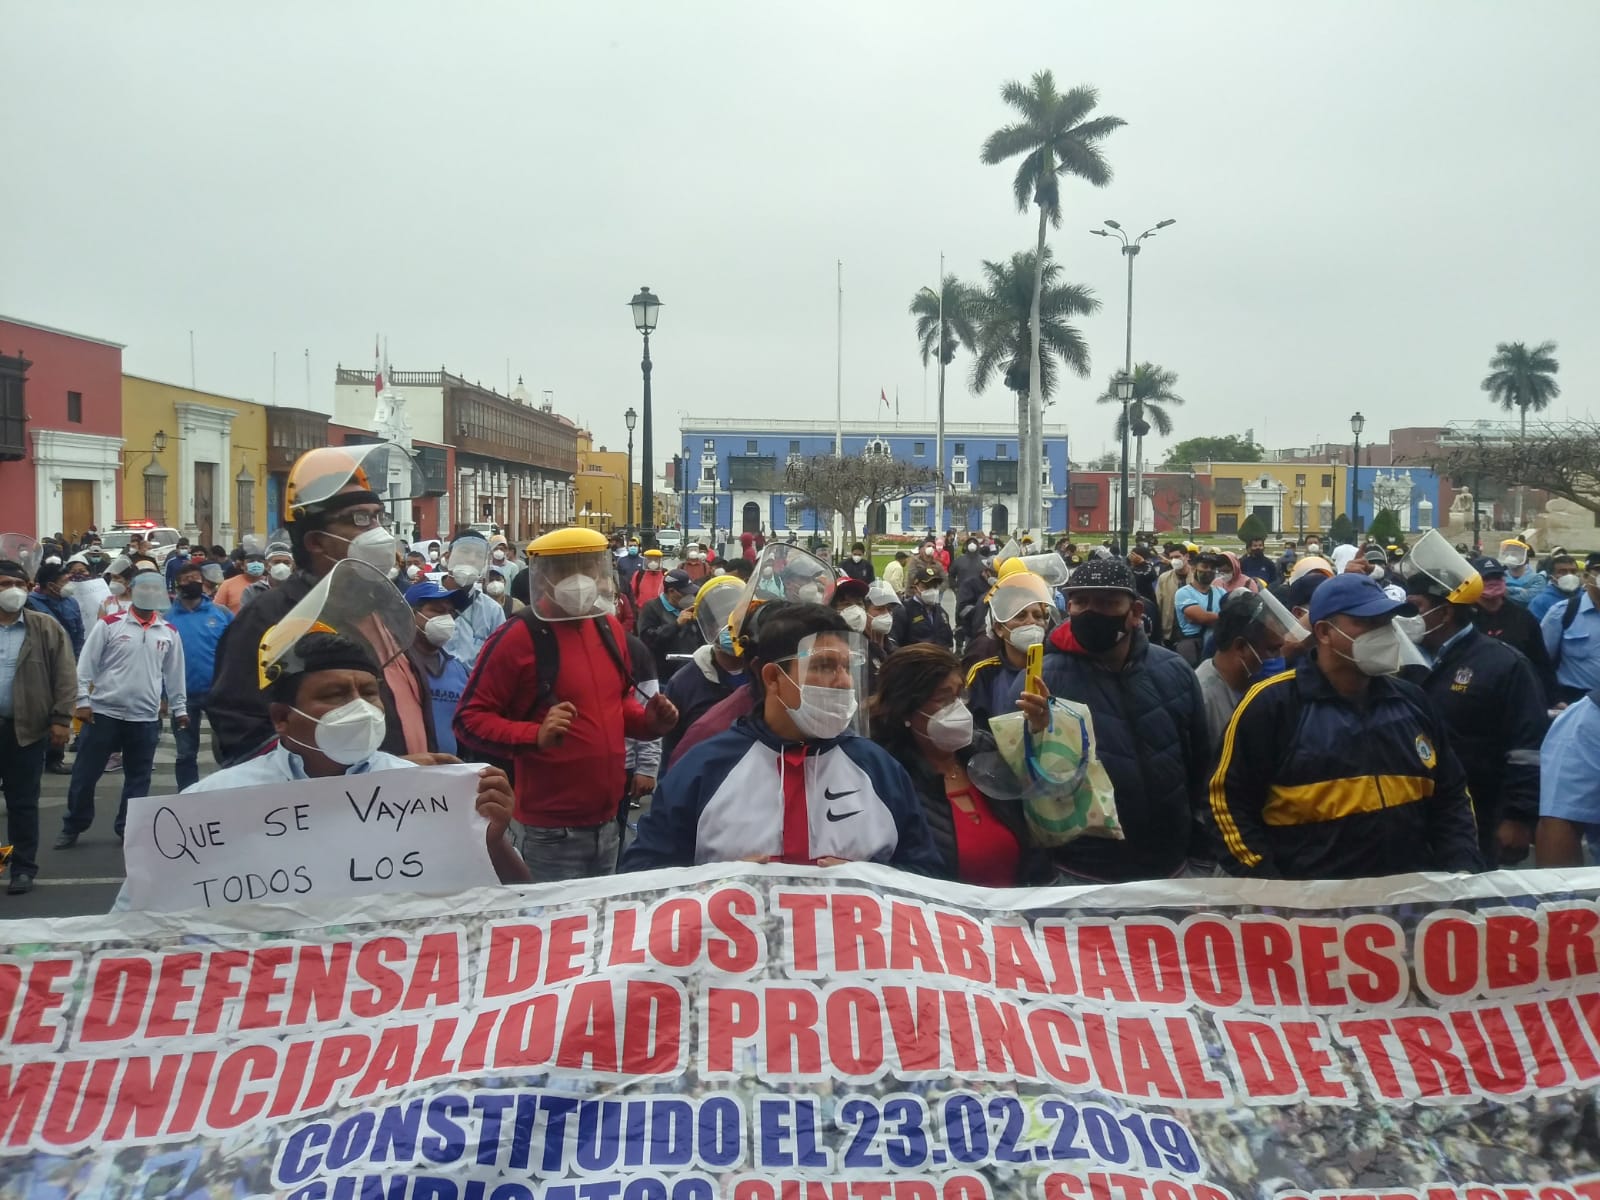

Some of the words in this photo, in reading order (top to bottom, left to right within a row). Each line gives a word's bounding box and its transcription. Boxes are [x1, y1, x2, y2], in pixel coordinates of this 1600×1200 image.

[152, 806, 226, 864] QUE
[264, 803, 311, 837] SE
[345, 785, 450, 832] VAYAN
[193, 866, 313, 908] TODOS
[349, 851, 424, 883] LOS
[0, 960, 72, 1044] E
[80, 933, 459, 1042] DEFENSA
[485, 916, 588, 997] DE
[608, 889, 758, 972] LOS
[779, 894, 1401, 1007] TRABAJADORES
[0, 980, 682, 1146] MUNICIPALIDAD
[708, 988, 1224, 1099] PROVINCIAL
[1224, 1022, 1348, 1099] DE
[278, 1094, 741, 1184] CONSTITUIDO
[760, 1100, 827, 1167] EL
[837, 1096, 1200, 1173] 23.02.2019
